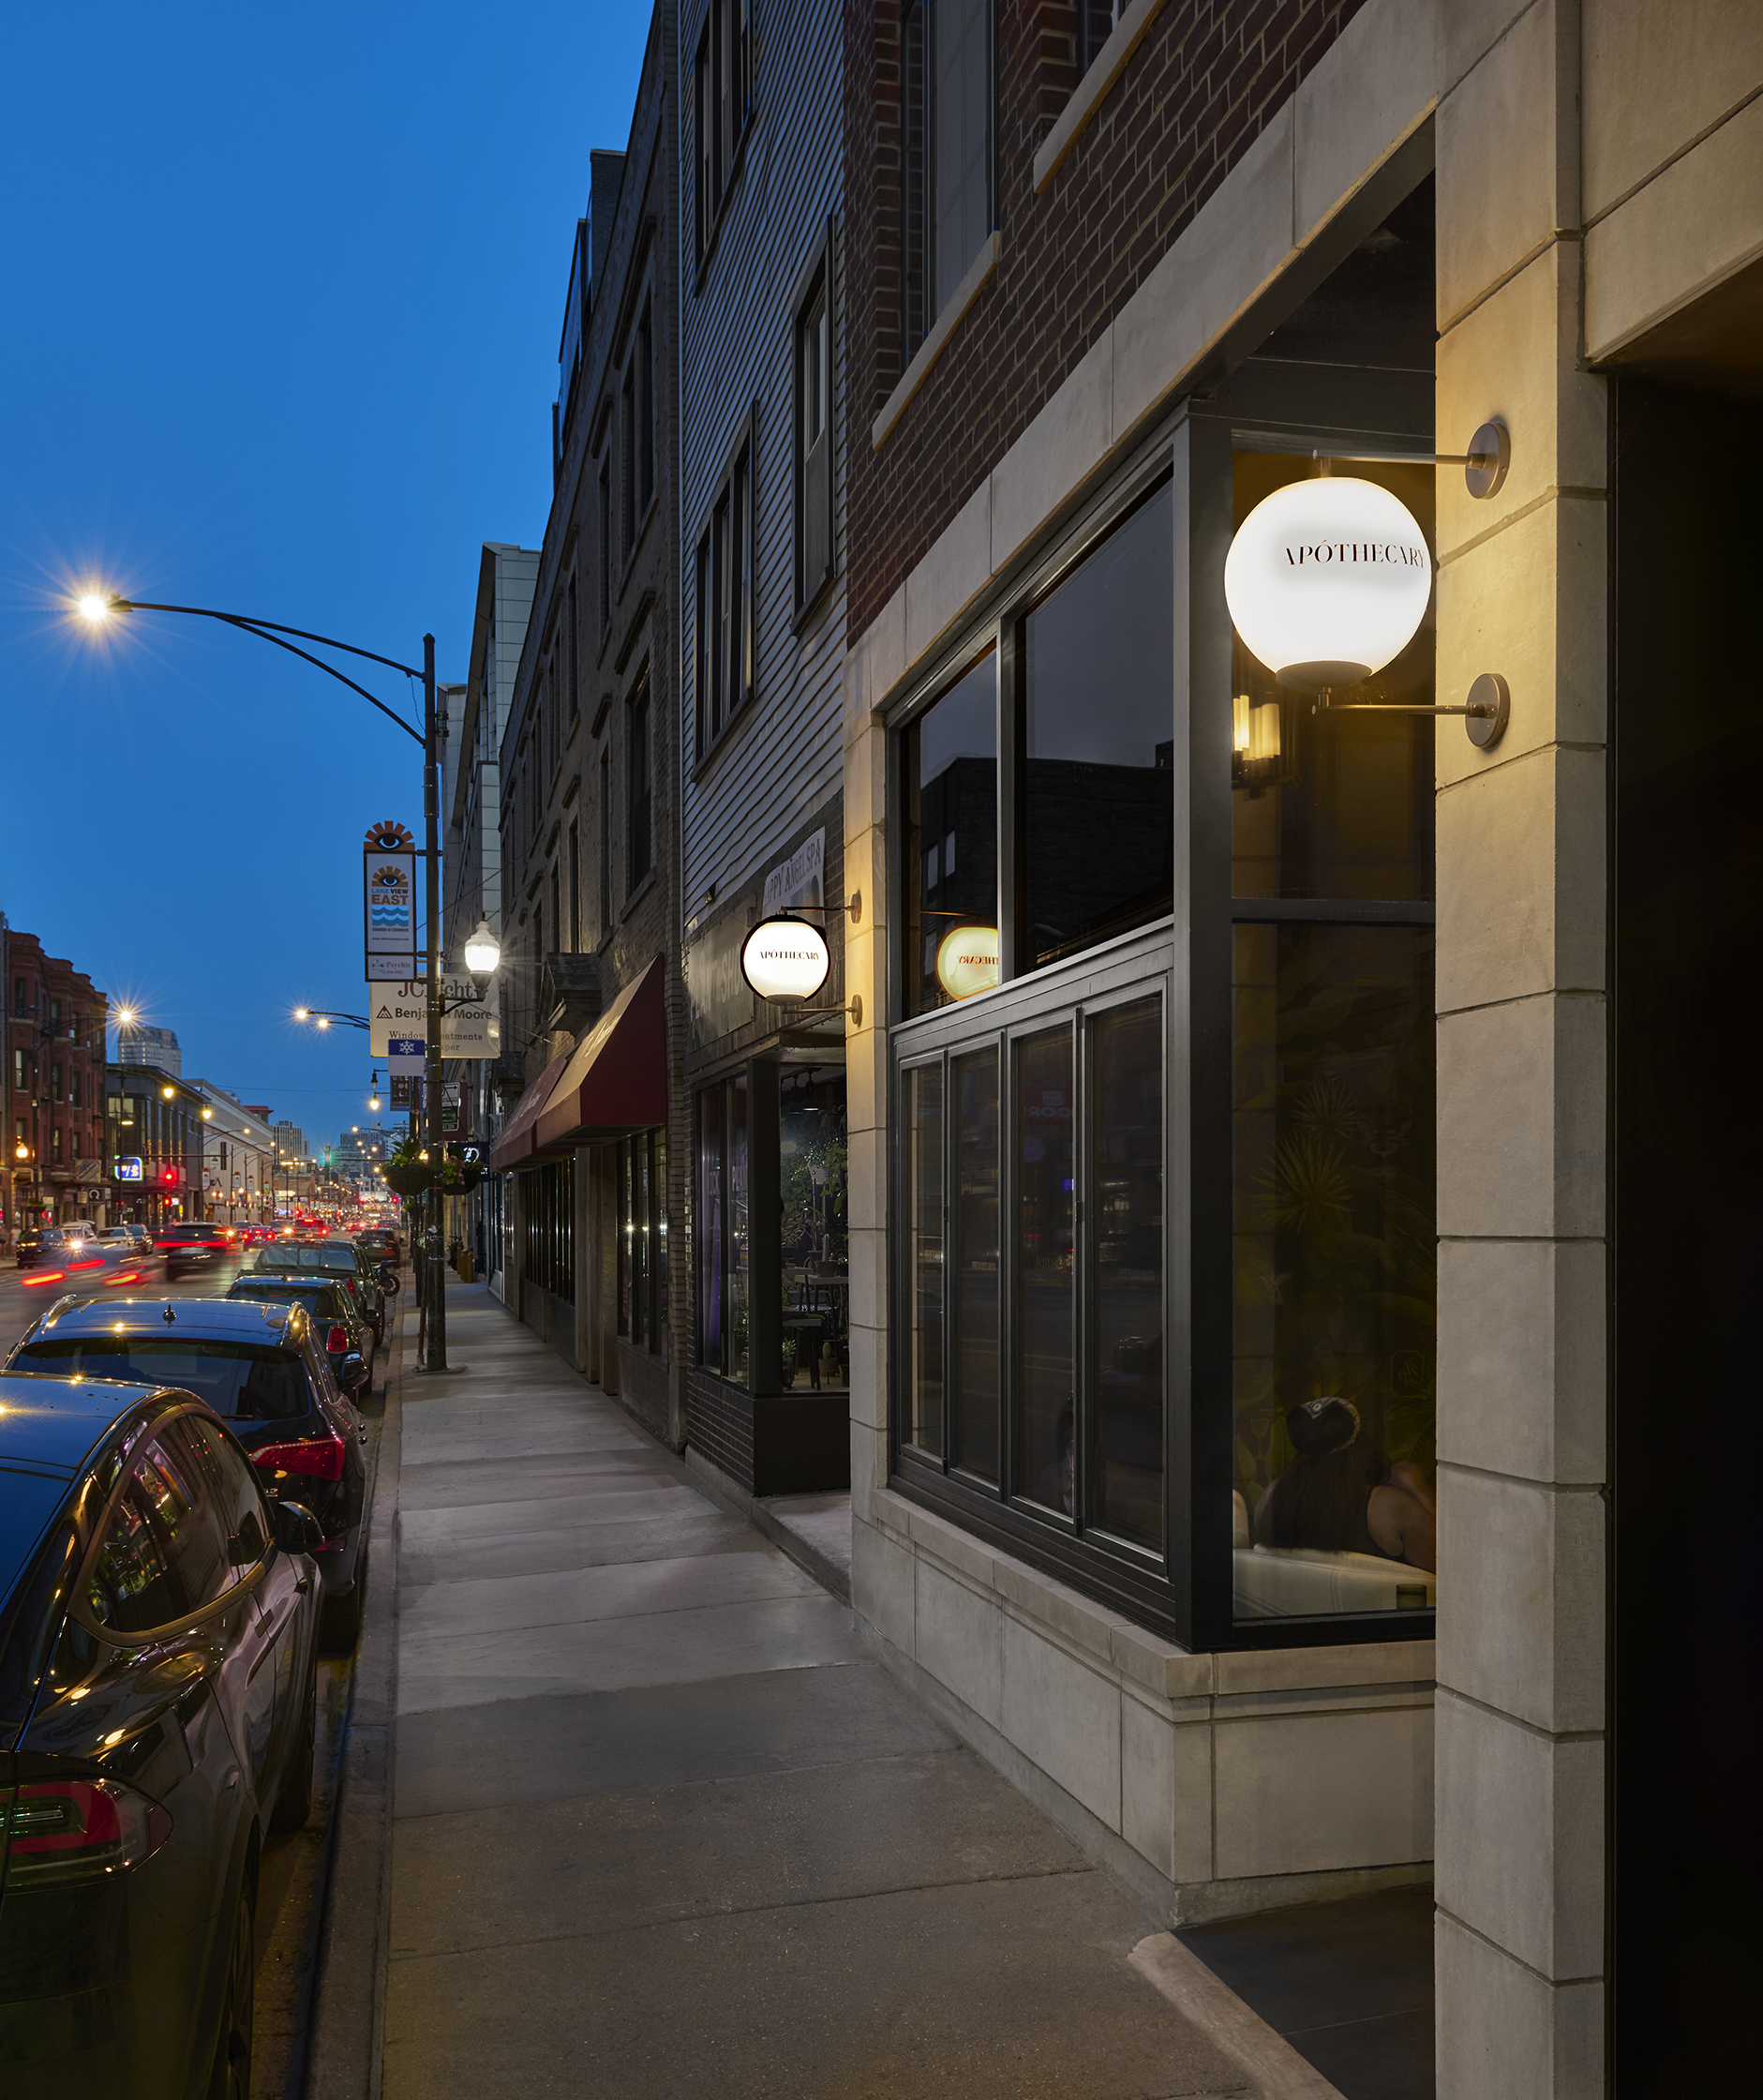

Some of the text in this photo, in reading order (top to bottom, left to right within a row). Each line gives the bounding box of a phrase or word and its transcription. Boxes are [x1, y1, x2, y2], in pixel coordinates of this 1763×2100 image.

[1284, 539, 1426, 568] APÓTHECARY
[784, 852, 806, 892] ANGEL
[806, 838, 822, 873] SPA
[371, 893, 409, 906] EAST
[759, 950, 821, 961] APÓTHECARY
[386, 961, 411, 969] Psychic
[454, 1009, 492, 1020] Moore
